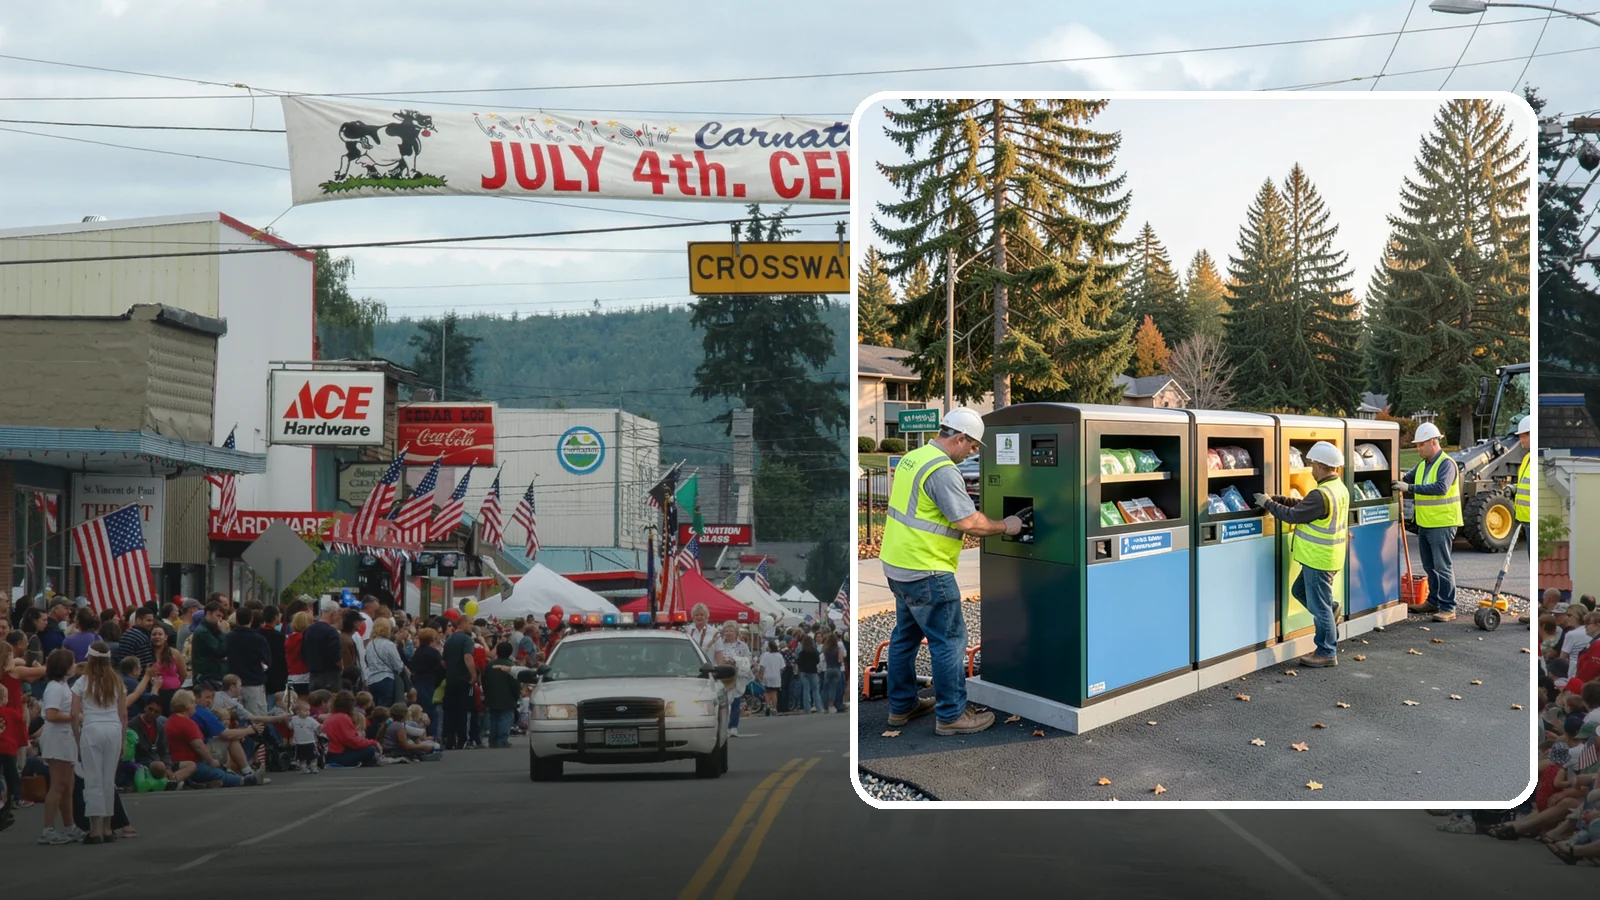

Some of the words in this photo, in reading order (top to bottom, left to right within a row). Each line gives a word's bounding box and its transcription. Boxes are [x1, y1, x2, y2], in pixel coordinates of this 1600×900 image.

[481, 140, 605, 192] JULY
[632, 150, 747, 198] 4th.
[697, 254, 850, 280] CROSSWA
[283, 380, 374, 420] ACE
[405, 409, 453, 422] CEDAR
[461, 409, 486, 422] LOG
[284, 421, 371, 436] Hardware
[353, 467, 385, 480] Simpl
[83, 485, 94, 494] St.
[95, 485, 125, 495] Vincent
[126, 486, 136, 495] de
[137, 486, 155, 495] Paul
[81, 503, 154, 522] THT
[212, 516, 330, 535] HARDARE
[688, 527, 741, 535] CRNATION
[699, 535, 730, 543] GLASS
